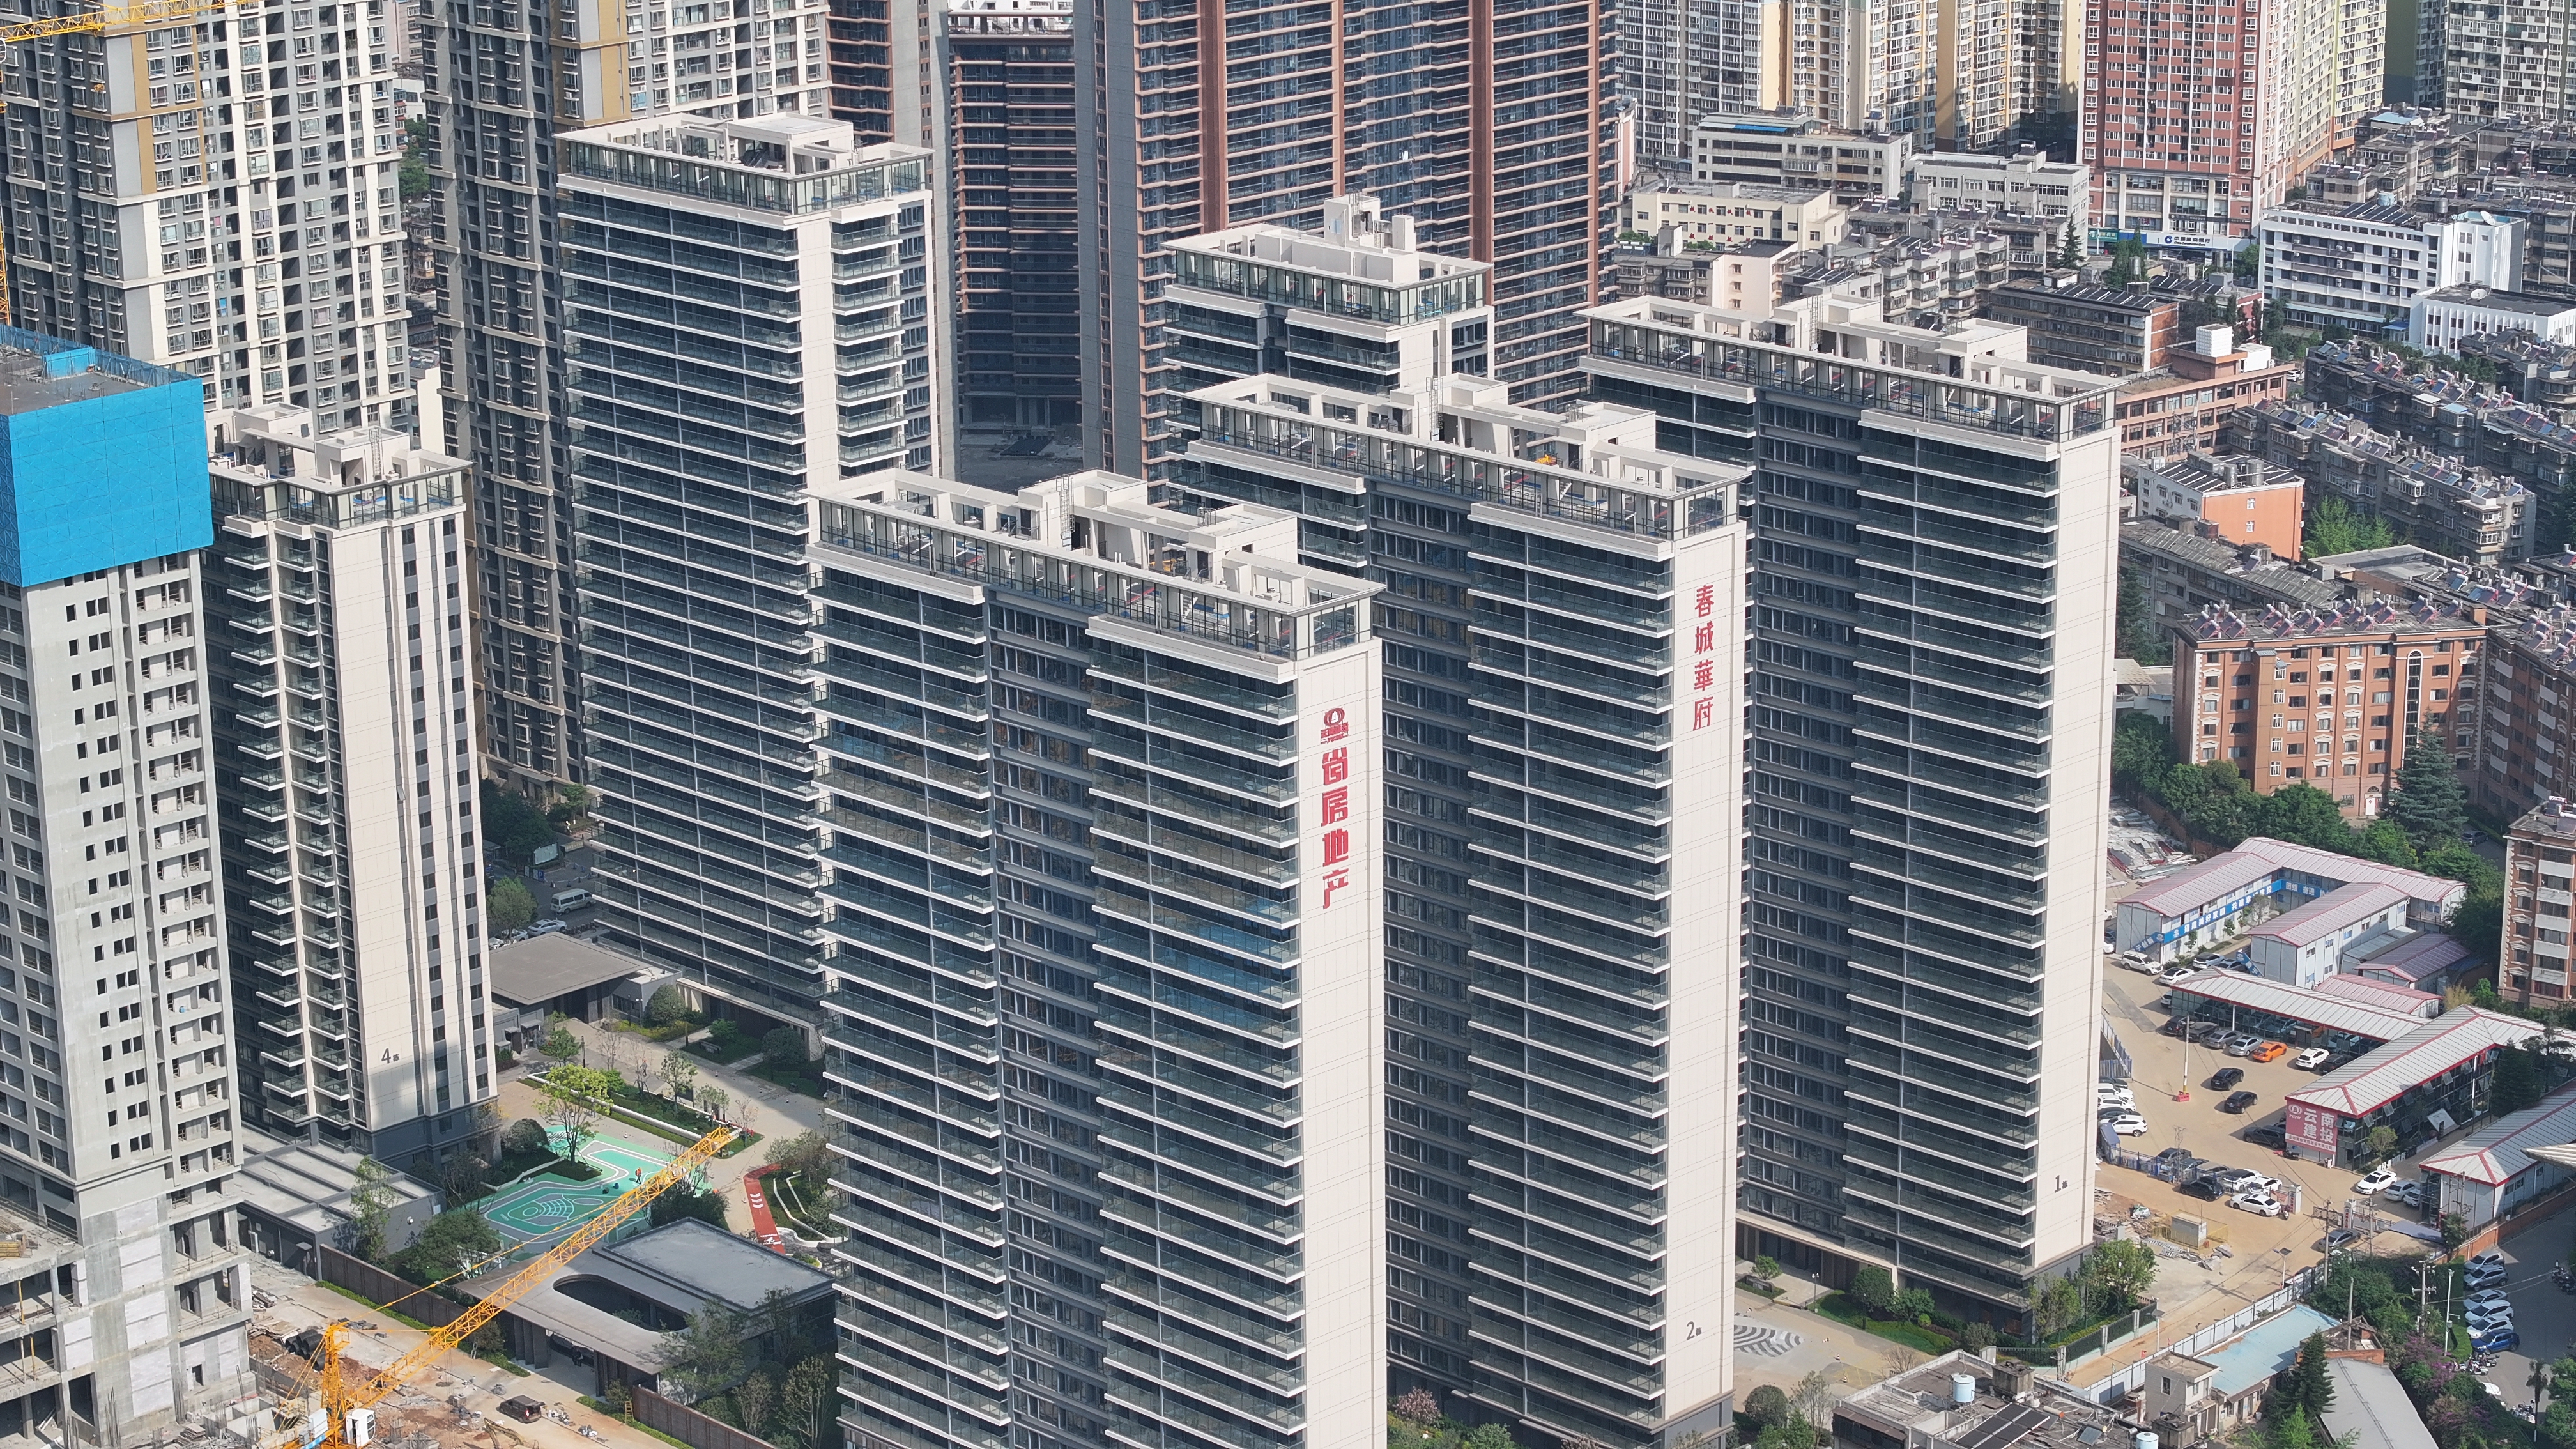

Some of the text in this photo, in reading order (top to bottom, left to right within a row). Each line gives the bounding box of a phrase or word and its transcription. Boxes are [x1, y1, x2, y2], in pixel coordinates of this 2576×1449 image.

[1693, 585, 1714, 731] 春城華府
[2304, 1108, 2334, 1128] 云南
[2303, 1123, 2334, 1144] 建投
